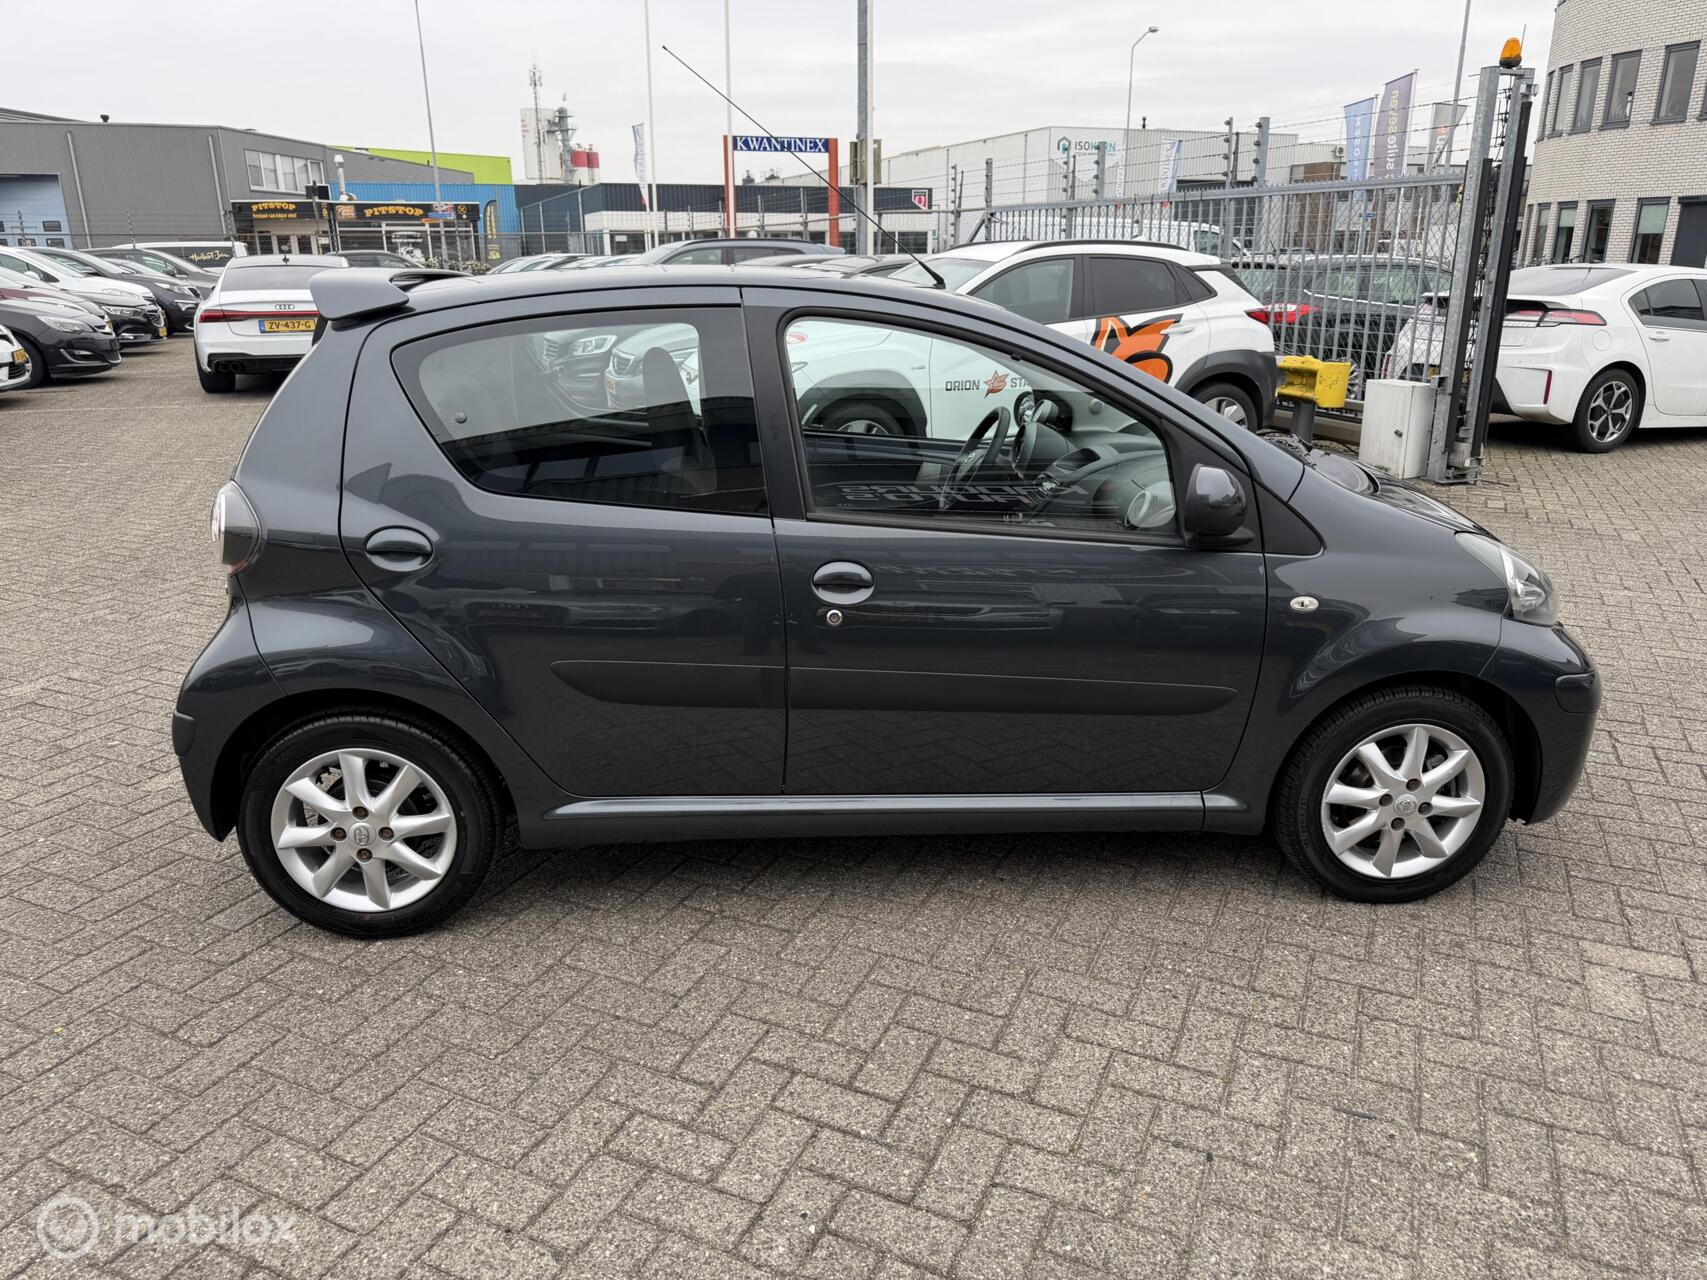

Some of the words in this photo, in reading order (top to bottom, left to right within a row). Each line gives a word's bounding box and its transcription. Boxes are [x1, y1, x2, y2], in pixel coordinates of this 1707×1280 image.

[736, 136, 826, 152] KWANTINEX
[1074, 140, 1116, 152] ISOKN
[251, 203, 296, 211] PITSTOP
[364, 206, 424, 217] PITSTOP
[269, 321, 311, 330] ZV-437-G
[945, 379, 980, 391] ORION
[1010, 377, 1031, 389] STA
